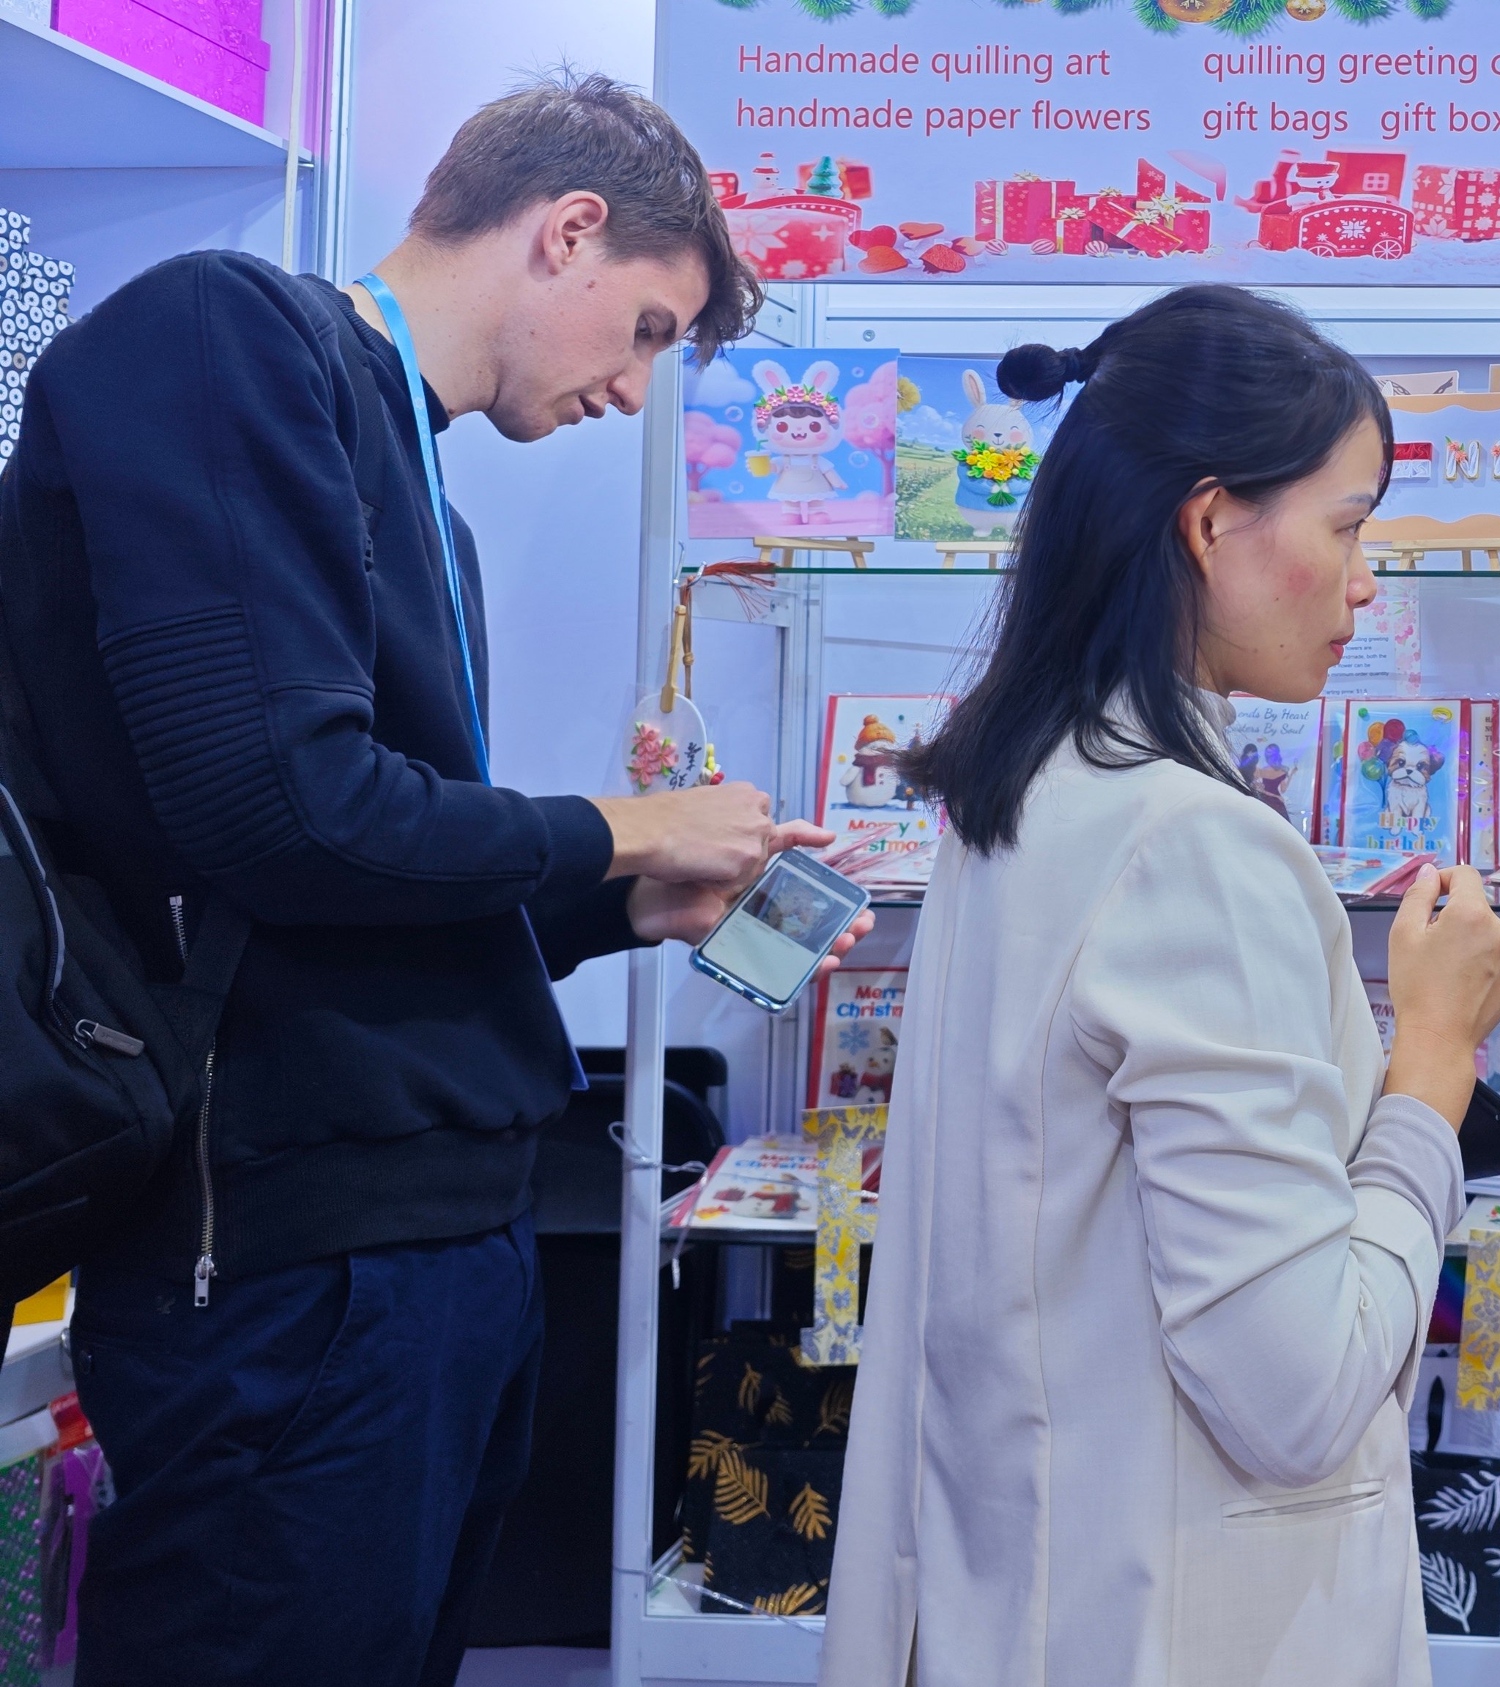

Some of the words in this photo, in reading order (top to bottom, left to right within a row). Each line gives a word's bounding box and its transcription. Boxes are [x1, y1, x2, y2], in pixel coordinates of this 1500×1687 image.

[739, 45, 919, 74] Handmade
[931, 46, 1053, 83] quilling
[1065, 51, 1109, 76] art
[1204, 46, 1325, 83] quilling
[1338, 47, 1478, 84] greeting
[738, 99, 913, 129] handmade
[926, 108, 1021, 136] paper
[1032, 100, 1150, 131] flowers
[1203, 101, 1257, 139] gift
[1270, 102, 1348, 140] bags
[1381, 102, 1435, 140] gift
[1264, 707, 1278, 722] By
[1281, 708, 1310, 720] Heart
[1263, 723, 1278, 736] By
[1280, 724, 1305, 735] Soul
[1378, 811, 1438, 832] Happy
[1366, 834, 1445, 852] birthday
[836, 1002, 904, 1018] Christm
